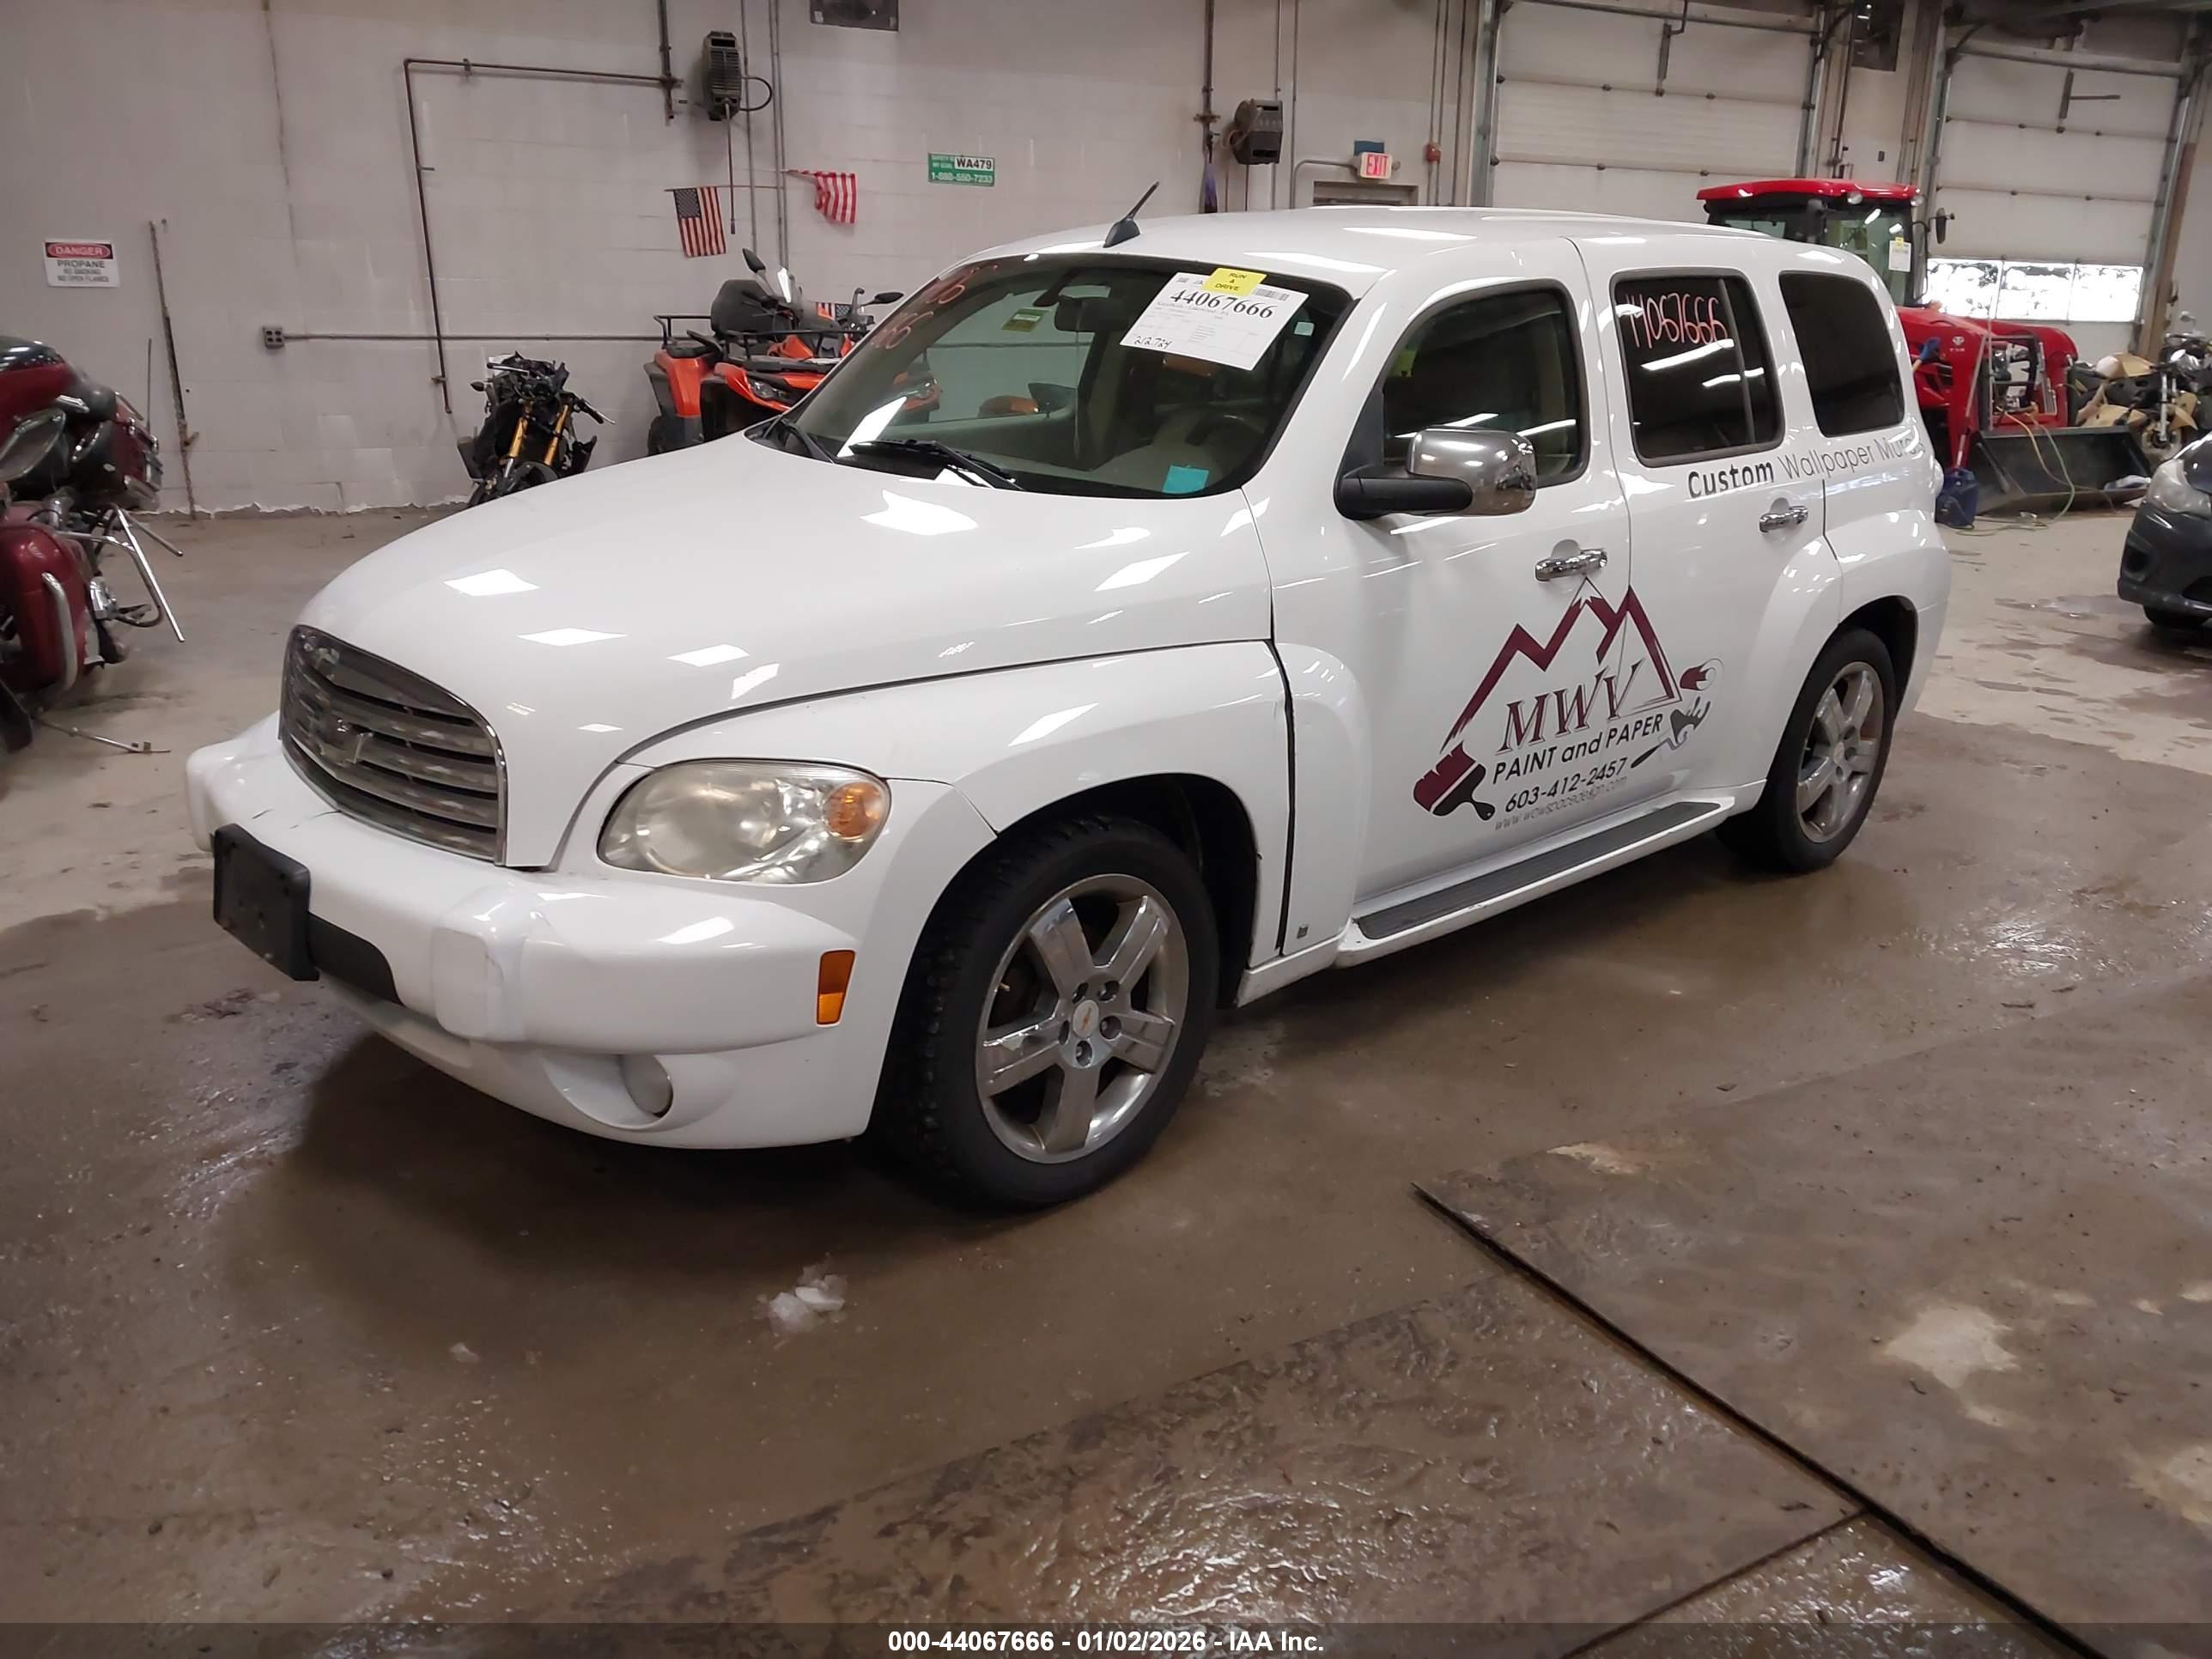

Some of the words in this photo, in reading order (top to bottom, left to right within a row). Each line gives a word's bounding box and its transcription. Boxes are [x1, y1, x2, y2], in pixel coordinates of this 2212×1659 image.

[957, 158, 992, 169] WA479
[1366, 154, 1388, 177] EXIT
[55, 246, 103, 256] DANGER
[57, 259, 105, 269] PROPANE
[1170, 289, 1278, 319] 44067666
[1688, 461, 1775, 499] Custom
[1778, 442, 1876, 480] Wallpaper
[1495, 657, 1644, 757] MWV
[1492, 746, 1557, 785] PAINT
[1561, 731, 1603, 763] and
[1605, 713, 1663, 749] PAPER
[1504, 757, 1628, 813] 603-412-2457
